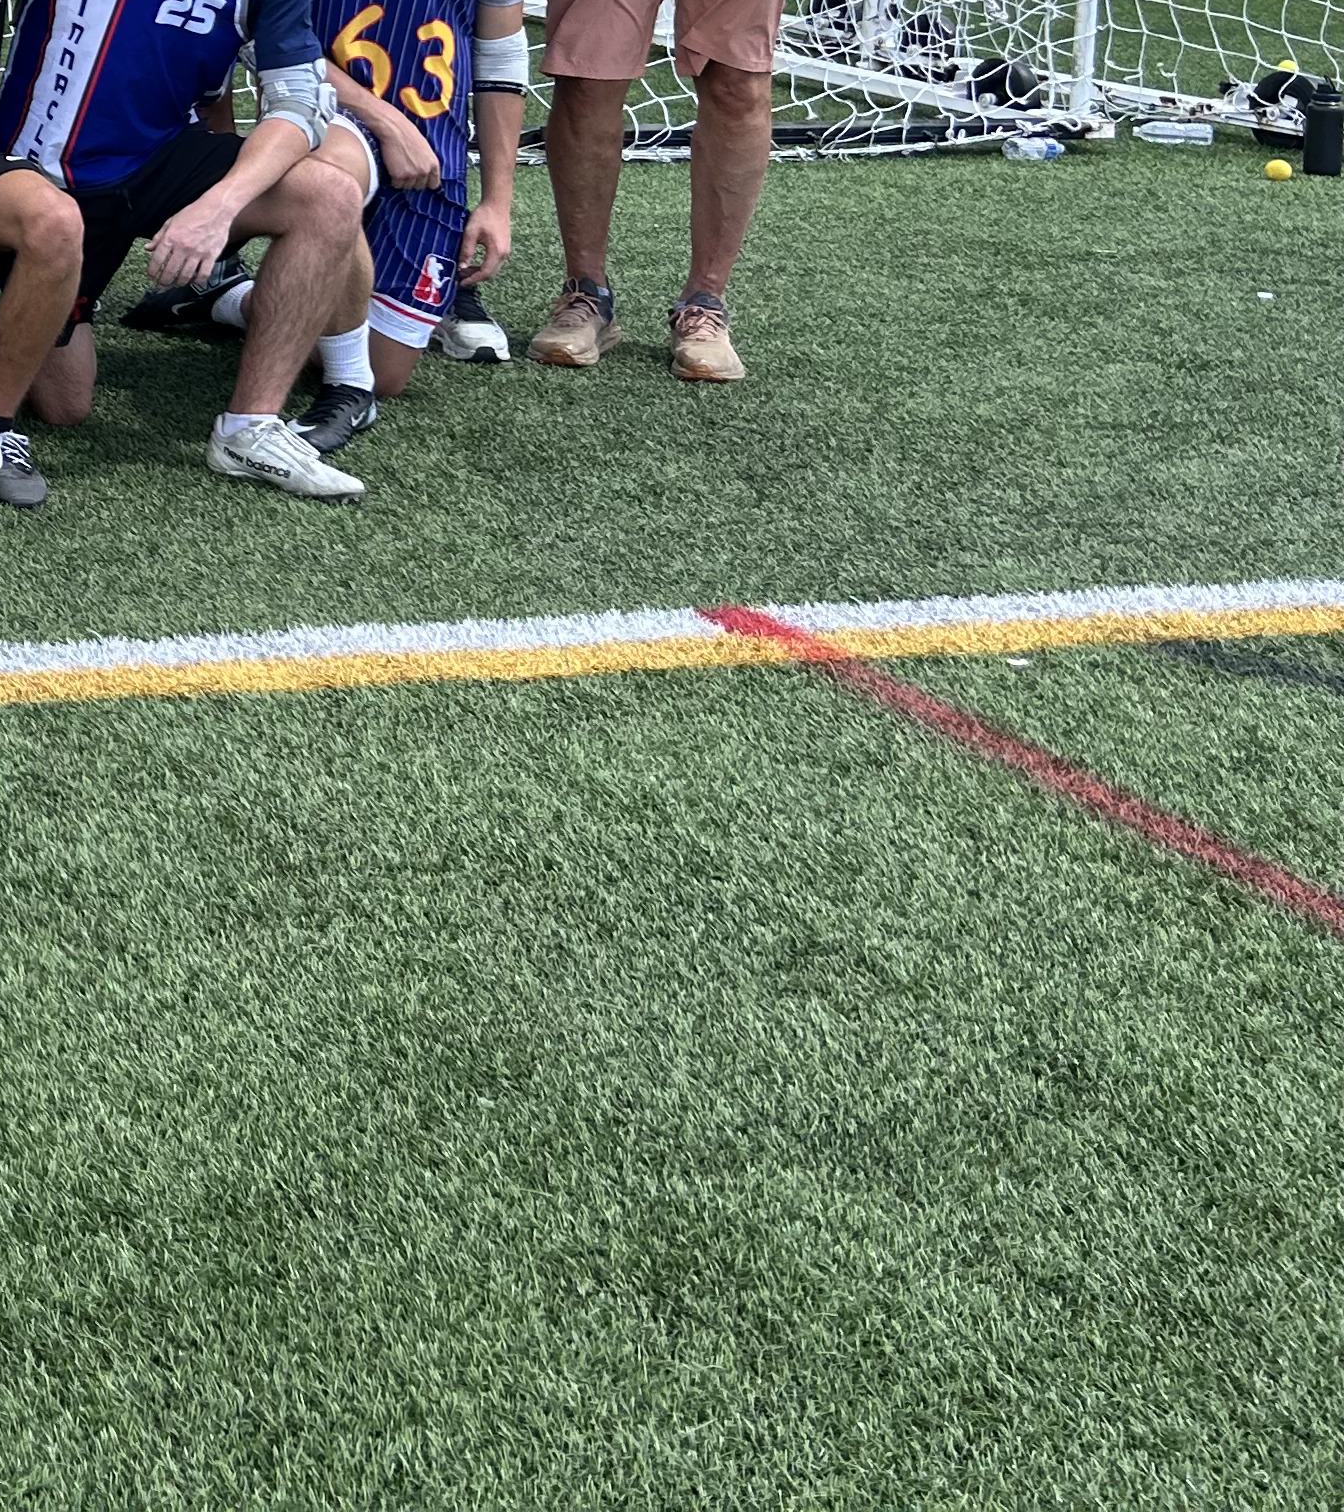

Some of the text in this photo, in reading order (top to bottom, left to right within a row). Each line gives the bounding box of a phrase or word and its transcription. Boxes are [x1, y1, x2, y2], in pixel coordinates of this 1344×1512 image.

[331, 3, 455, 119] 63
[223, 446, 291, 479] new balance
